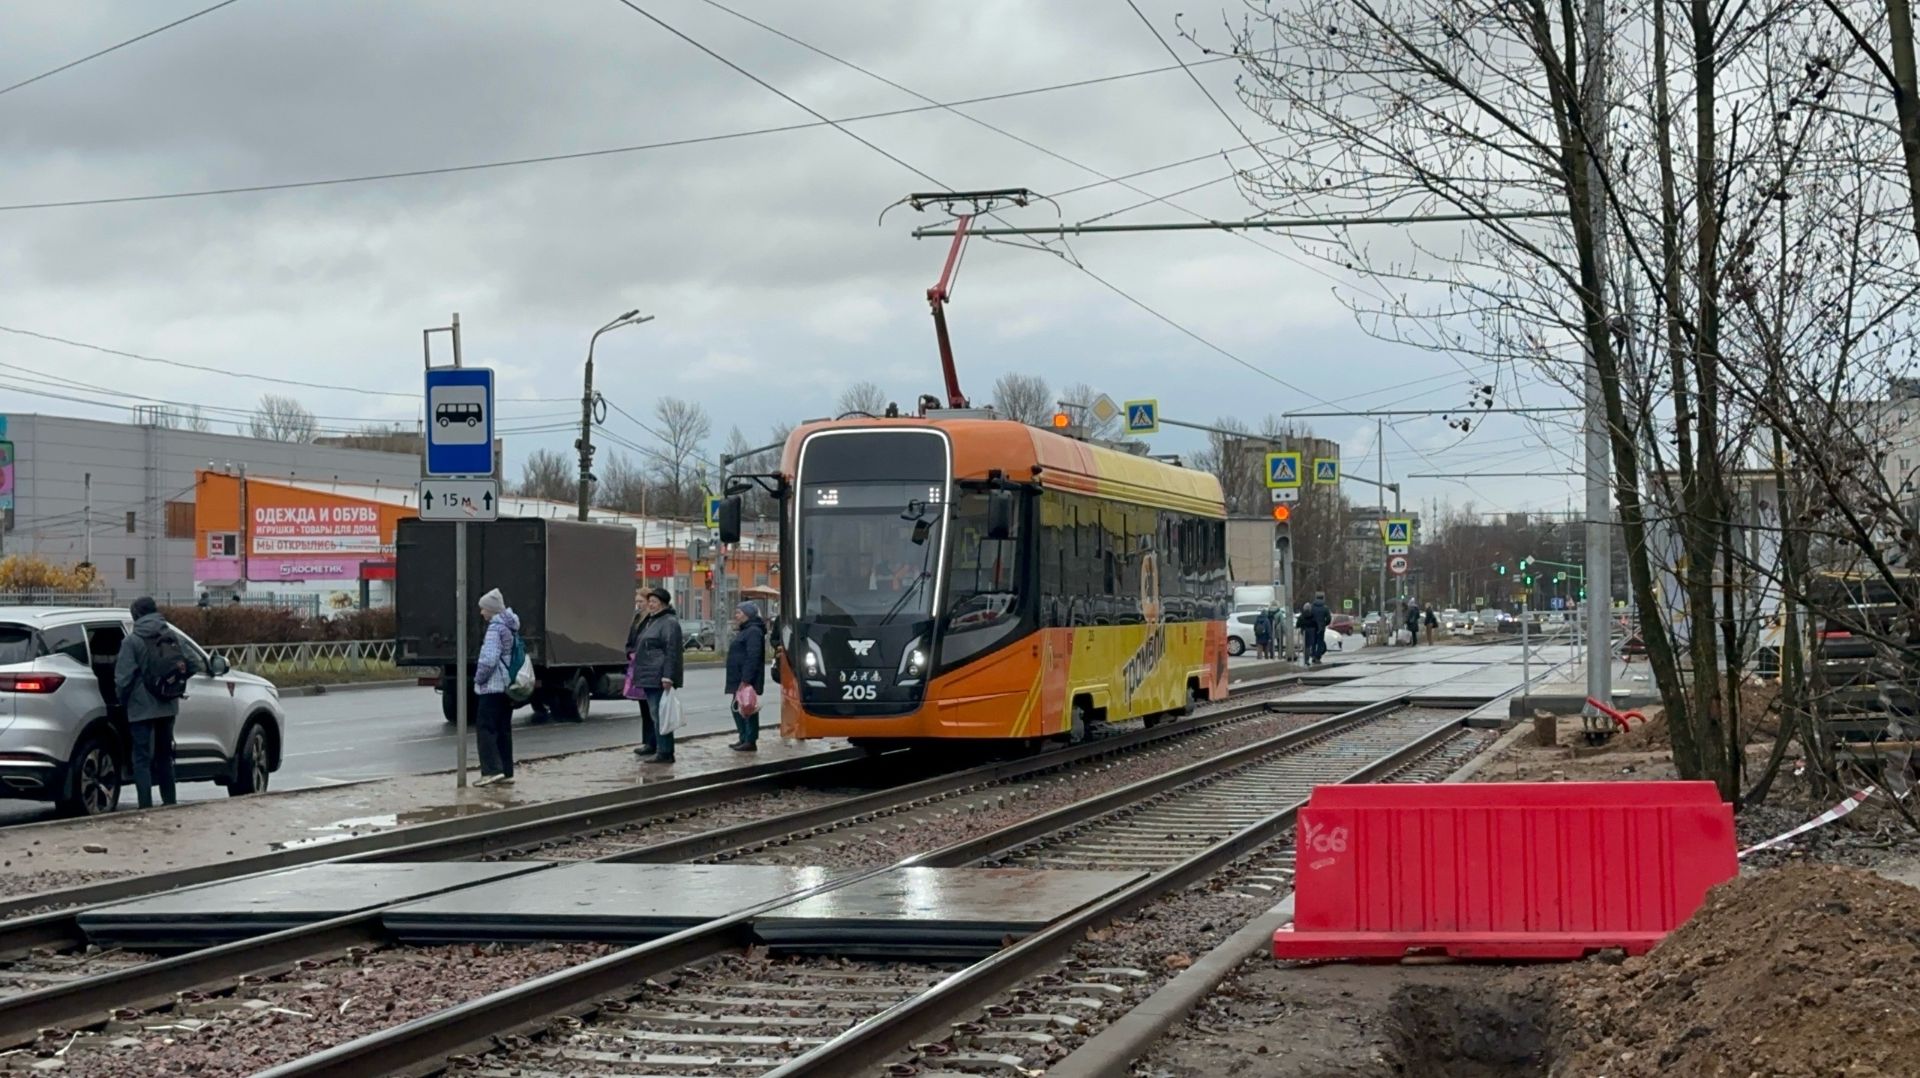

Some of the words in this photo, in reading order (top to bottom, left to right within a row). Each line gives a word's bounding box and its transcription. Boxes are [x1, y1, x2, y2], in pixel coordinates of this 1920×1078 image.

[442, 493, 458, 507] 15
[255, 507, 316, 524] ОДЕЖДА
[319, 508, 329, 522] И
[332, 507, 377, 522] ОБУВЬ
[256, 525, 295, 534] ИГРУШКИ
[300, 525, 333, 534] ТОВАРЫ
[334, 525, 352, 535] ДЛЯ
[354, 525, 377, 535] ДОМА
[256, 540, 274, 551] МЫ
[276, 540, 337, 551] ОТКРЫЛИСЬ
[291, 565, 344, 574] КОСМЕТИК
[842, 684, 877, 700] 205
